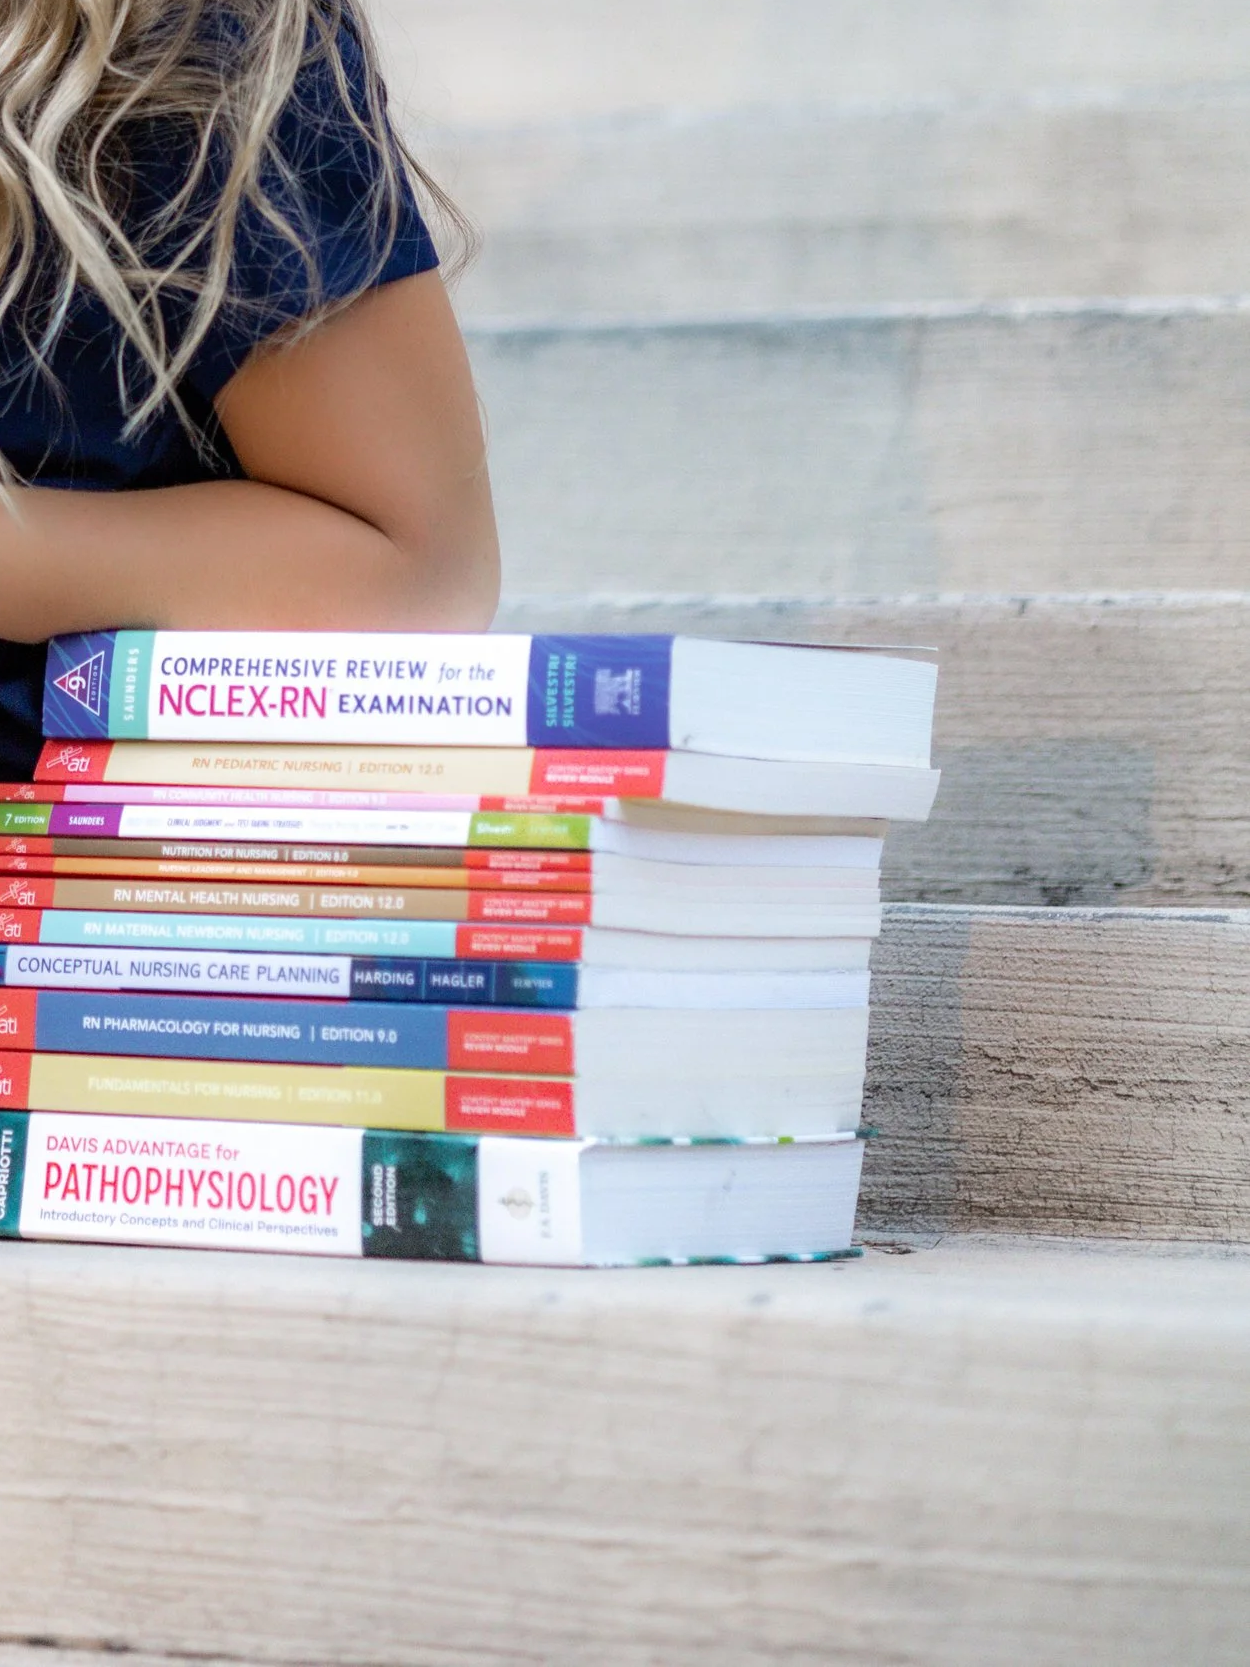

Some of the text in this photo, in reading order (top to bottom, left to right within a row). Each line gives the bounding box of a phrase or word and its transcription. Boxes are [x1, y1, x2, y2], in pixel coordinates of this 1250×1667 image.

[68, 675, 86, 691] 9
[91, 665, 99, 702] EDITION
[161, 656, 496, 684] COMPREHENSIVE REVIEW for the
[123, 648, 140, 721] SAUNDERS
[545, 653, 560, 727] SILVESTRI
[562, 653, 577, 727] SILVESTRI
[158, 683, 512, 718] NCLEX-RN EXAMINATION
[192, 757, 444, 775] RN PEDIATRIC NURSING EDITION 12.0
[14, 815, 46, 825] EDITION
[68, 815, 105, 826] SAUNDERS
[162, 846, 212, 858] NUTRITION
[213, 847, 233, 859] FOR
[235, 848, 278, 861] NURSING
[292, 850, 332, 862] EDITION
[113, 889, 405, 910] RN MENTAL HEALTH NURSING EDITION 12.0
[83, 922, 102, 935] RN
[105, 923, 173, 938] MATERNAL
[176, 925, 242, 940] NEWBORN
[245, 927, 304, 942] NURSING
[325, 930, 378, 945] EDITION
[17, 956, 340, 985] CONCEPTUAL NURSING CARE PLANNING
[355, 968, 415, 986] HARDING
[431, 972, 485, 989] HAGLER
[83, 1016, 398, 1044] RN PHARMACOLOGY FOR NURSING EDITION 9.0
[88, 1076, 191, 1096] FUNDAMENTALS
[194, 1082, 220, 1097] FOR
[223, 1084, 282, 1100] NURSING
[46, 1135, 240, 1161] DAVIS ADVANTAGE for
[43, 1161, 339, 1216] PATHOPHYSIOLOGY
[371, 1163, 384, 1226] SECOND
[385, 1165, 398, 1227] EDITION
[40, 1208, 339, 1238] Introductory Concepts and Clinical Perspectives
